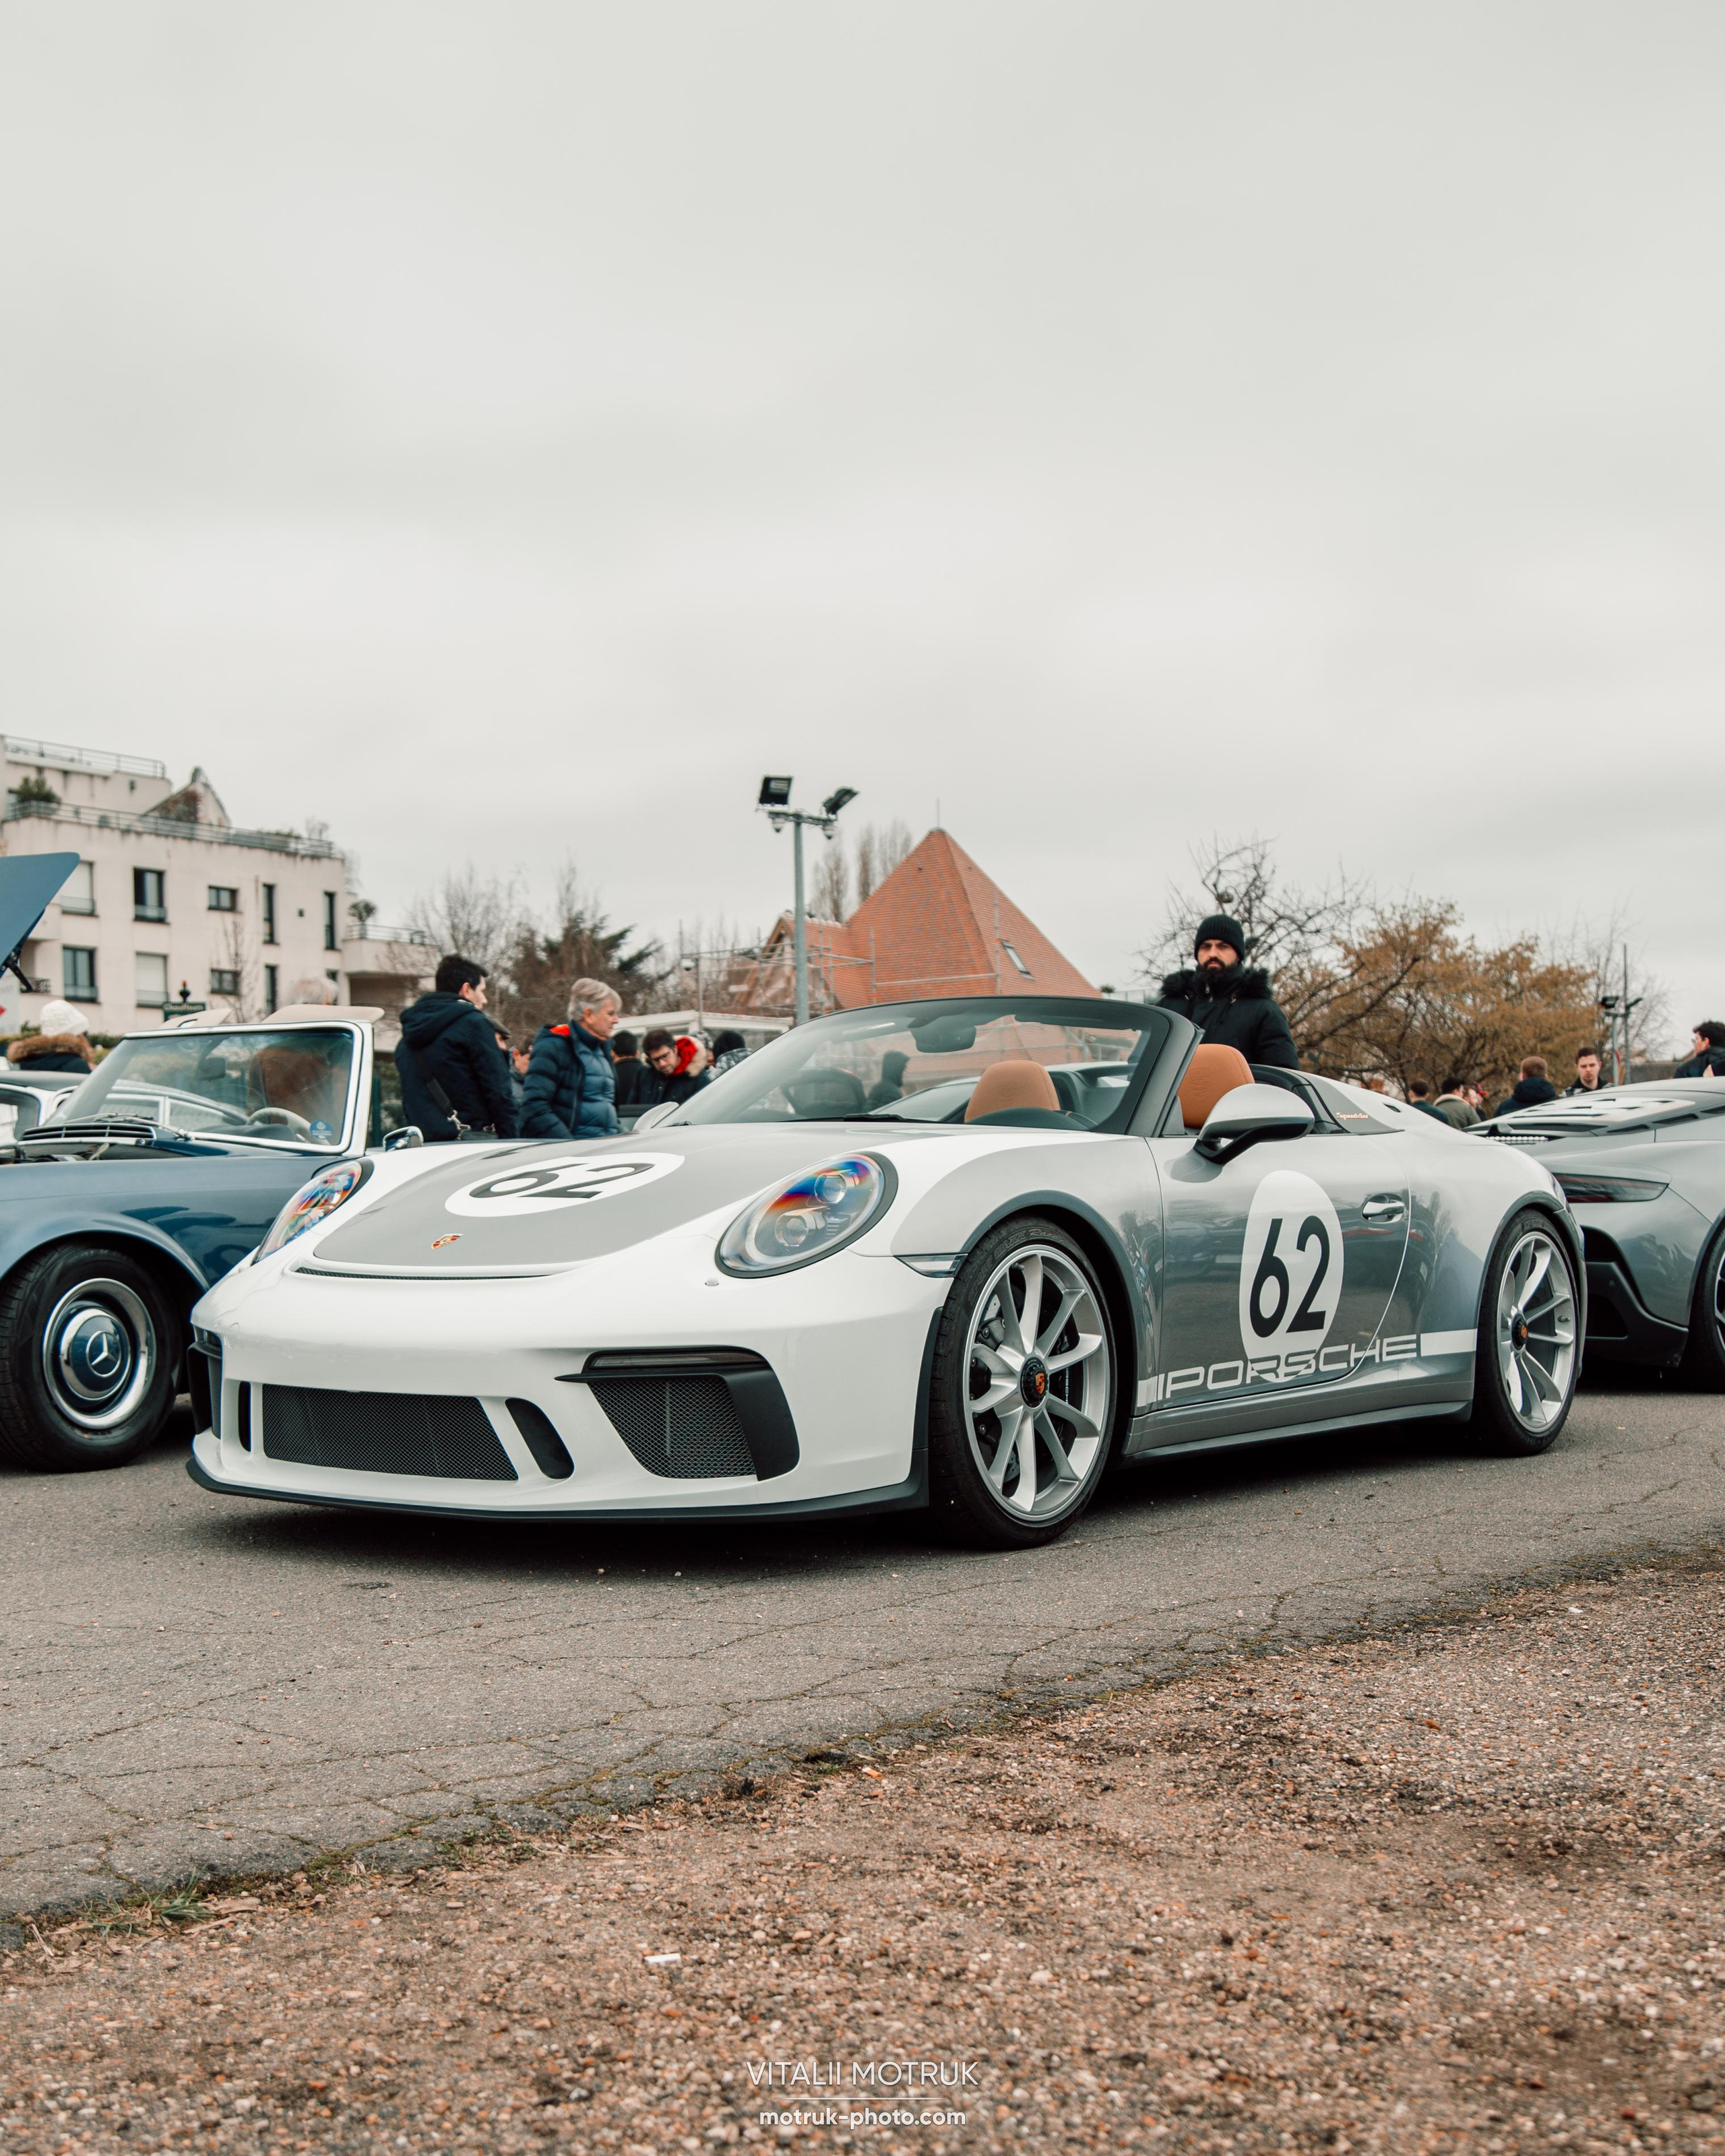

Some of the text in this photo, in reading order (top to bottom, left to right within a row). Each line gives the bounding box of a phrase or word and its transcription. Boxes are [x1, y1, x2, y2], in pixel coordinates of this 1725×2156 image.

[1336, 1112, 1369, 1120] Speedster
[469, 1162, 656, 1199] 62
[1249, 1215, 1330, 1338] 62
[1165, 1333, 1417, 1399] PORSCHE
